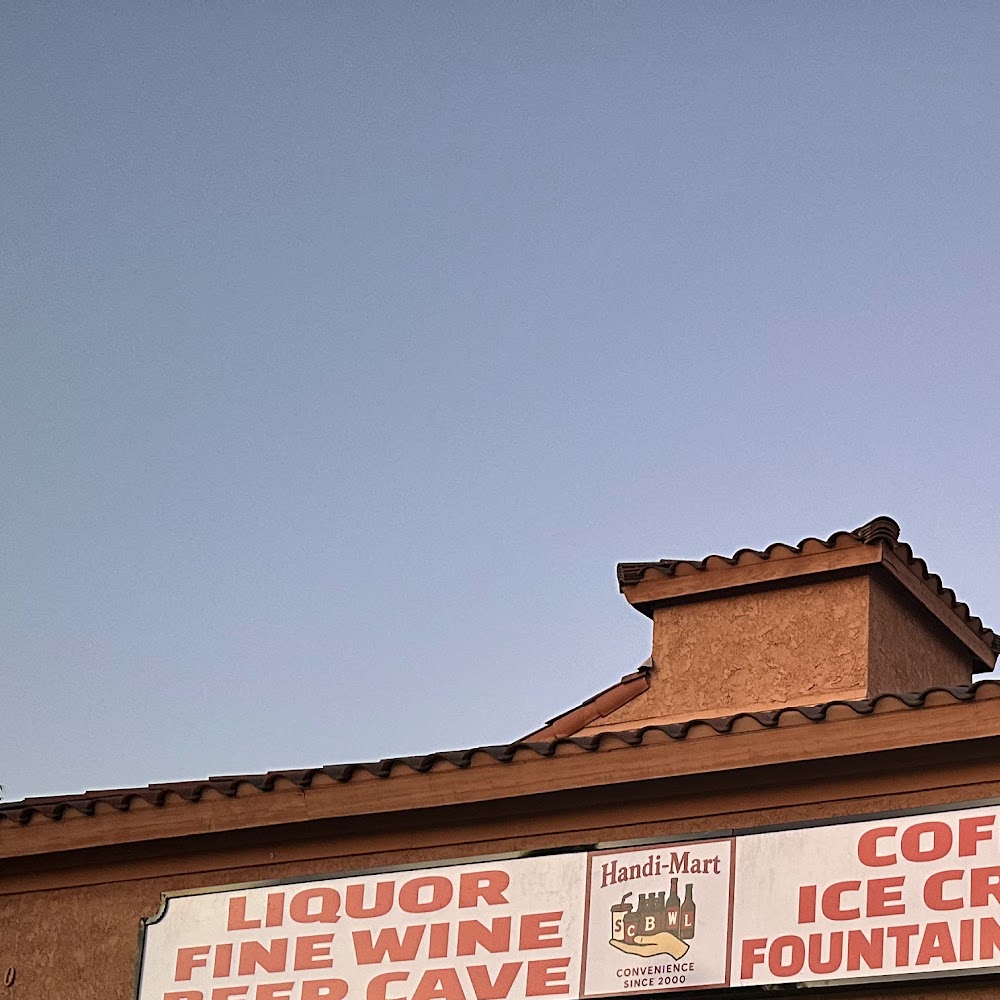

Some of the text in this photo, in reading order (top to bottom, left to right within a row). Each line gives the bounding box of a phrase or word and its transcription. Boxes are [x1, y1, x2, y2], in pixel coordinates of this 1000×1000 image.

[600, 851, 722, 889] Handi-Mart
[226, 869, 511, 932] LIQUOR
[797, 877, 908, 926] ICE
[644, 916, 656, 931] B
[667, 911, 678, 926] W
[684, 914, 692, 926] L
[174, 910, 565, 983] FINE WINE
[616, 962, 695, 977] CONVENIENCE
[624, 975, 686, 989] SINCE 2000
